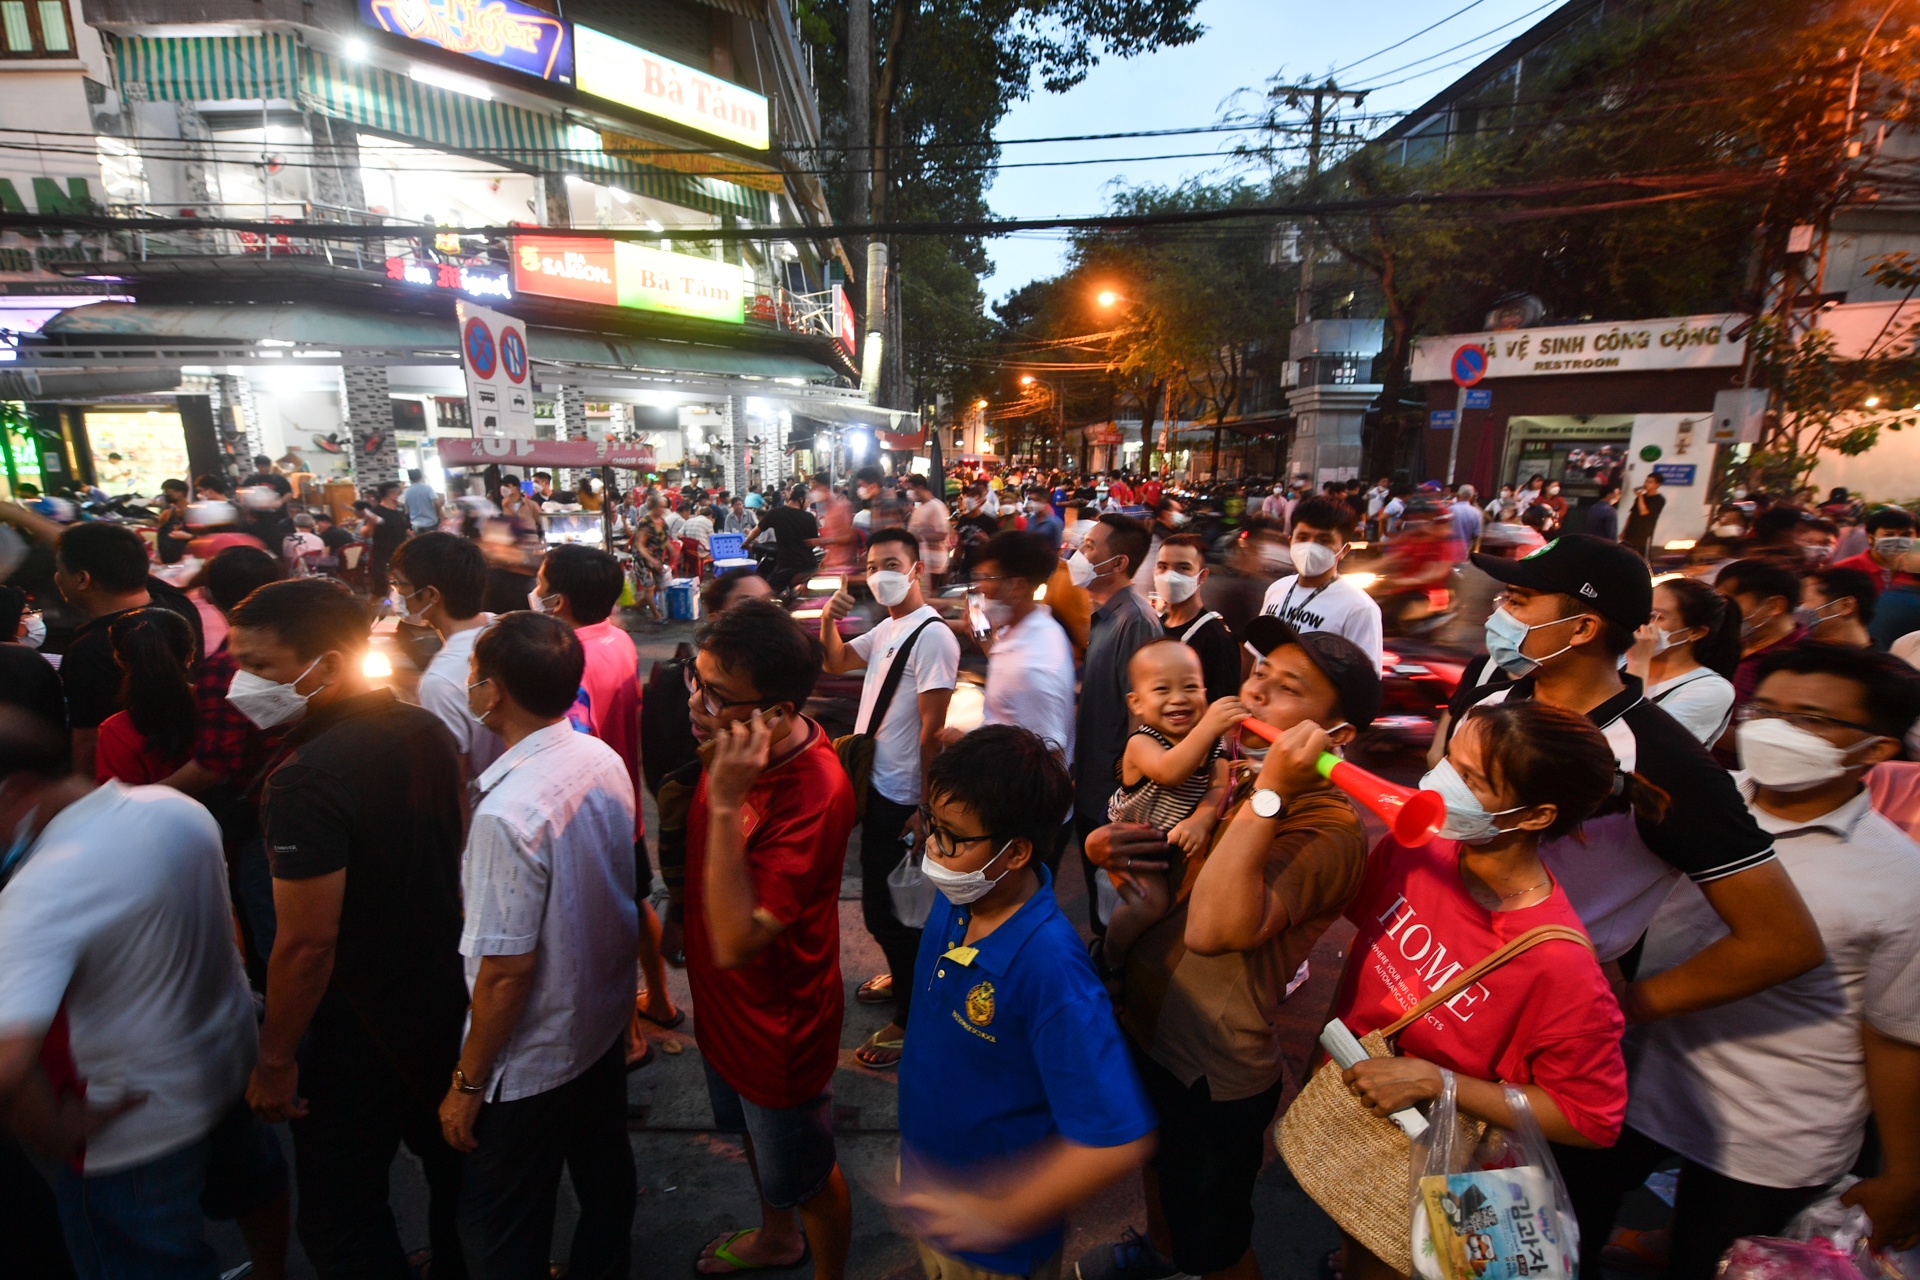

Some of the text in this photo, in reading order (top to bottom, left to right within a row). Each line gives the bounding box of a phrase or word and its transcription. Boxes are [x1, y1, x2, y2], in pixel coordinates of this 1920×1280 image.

[642, 58, 757, 131] Bà Tám
[640, 269, 670, 291] Bà
[1506, 334, 1530, 361] VỆ
[1539, 335, 1586, 356] SINH
[1594, 327, 1652, 351] CÔNG
[1660, 322, 1721, 351] CỘNG
[1534, 357, 1620, 371] RESTROOM
[1371, 941, 1390, 965] WHERE
[1386, 963, 1402, 982] YOUR
[1397, 978, 1410, 996] WIFI
[1407, 993, 1445, 1031] COECTS
[1376, 892, 1490, 1022] HOME
[1510, 1196, 1550, 1274] 김과자
